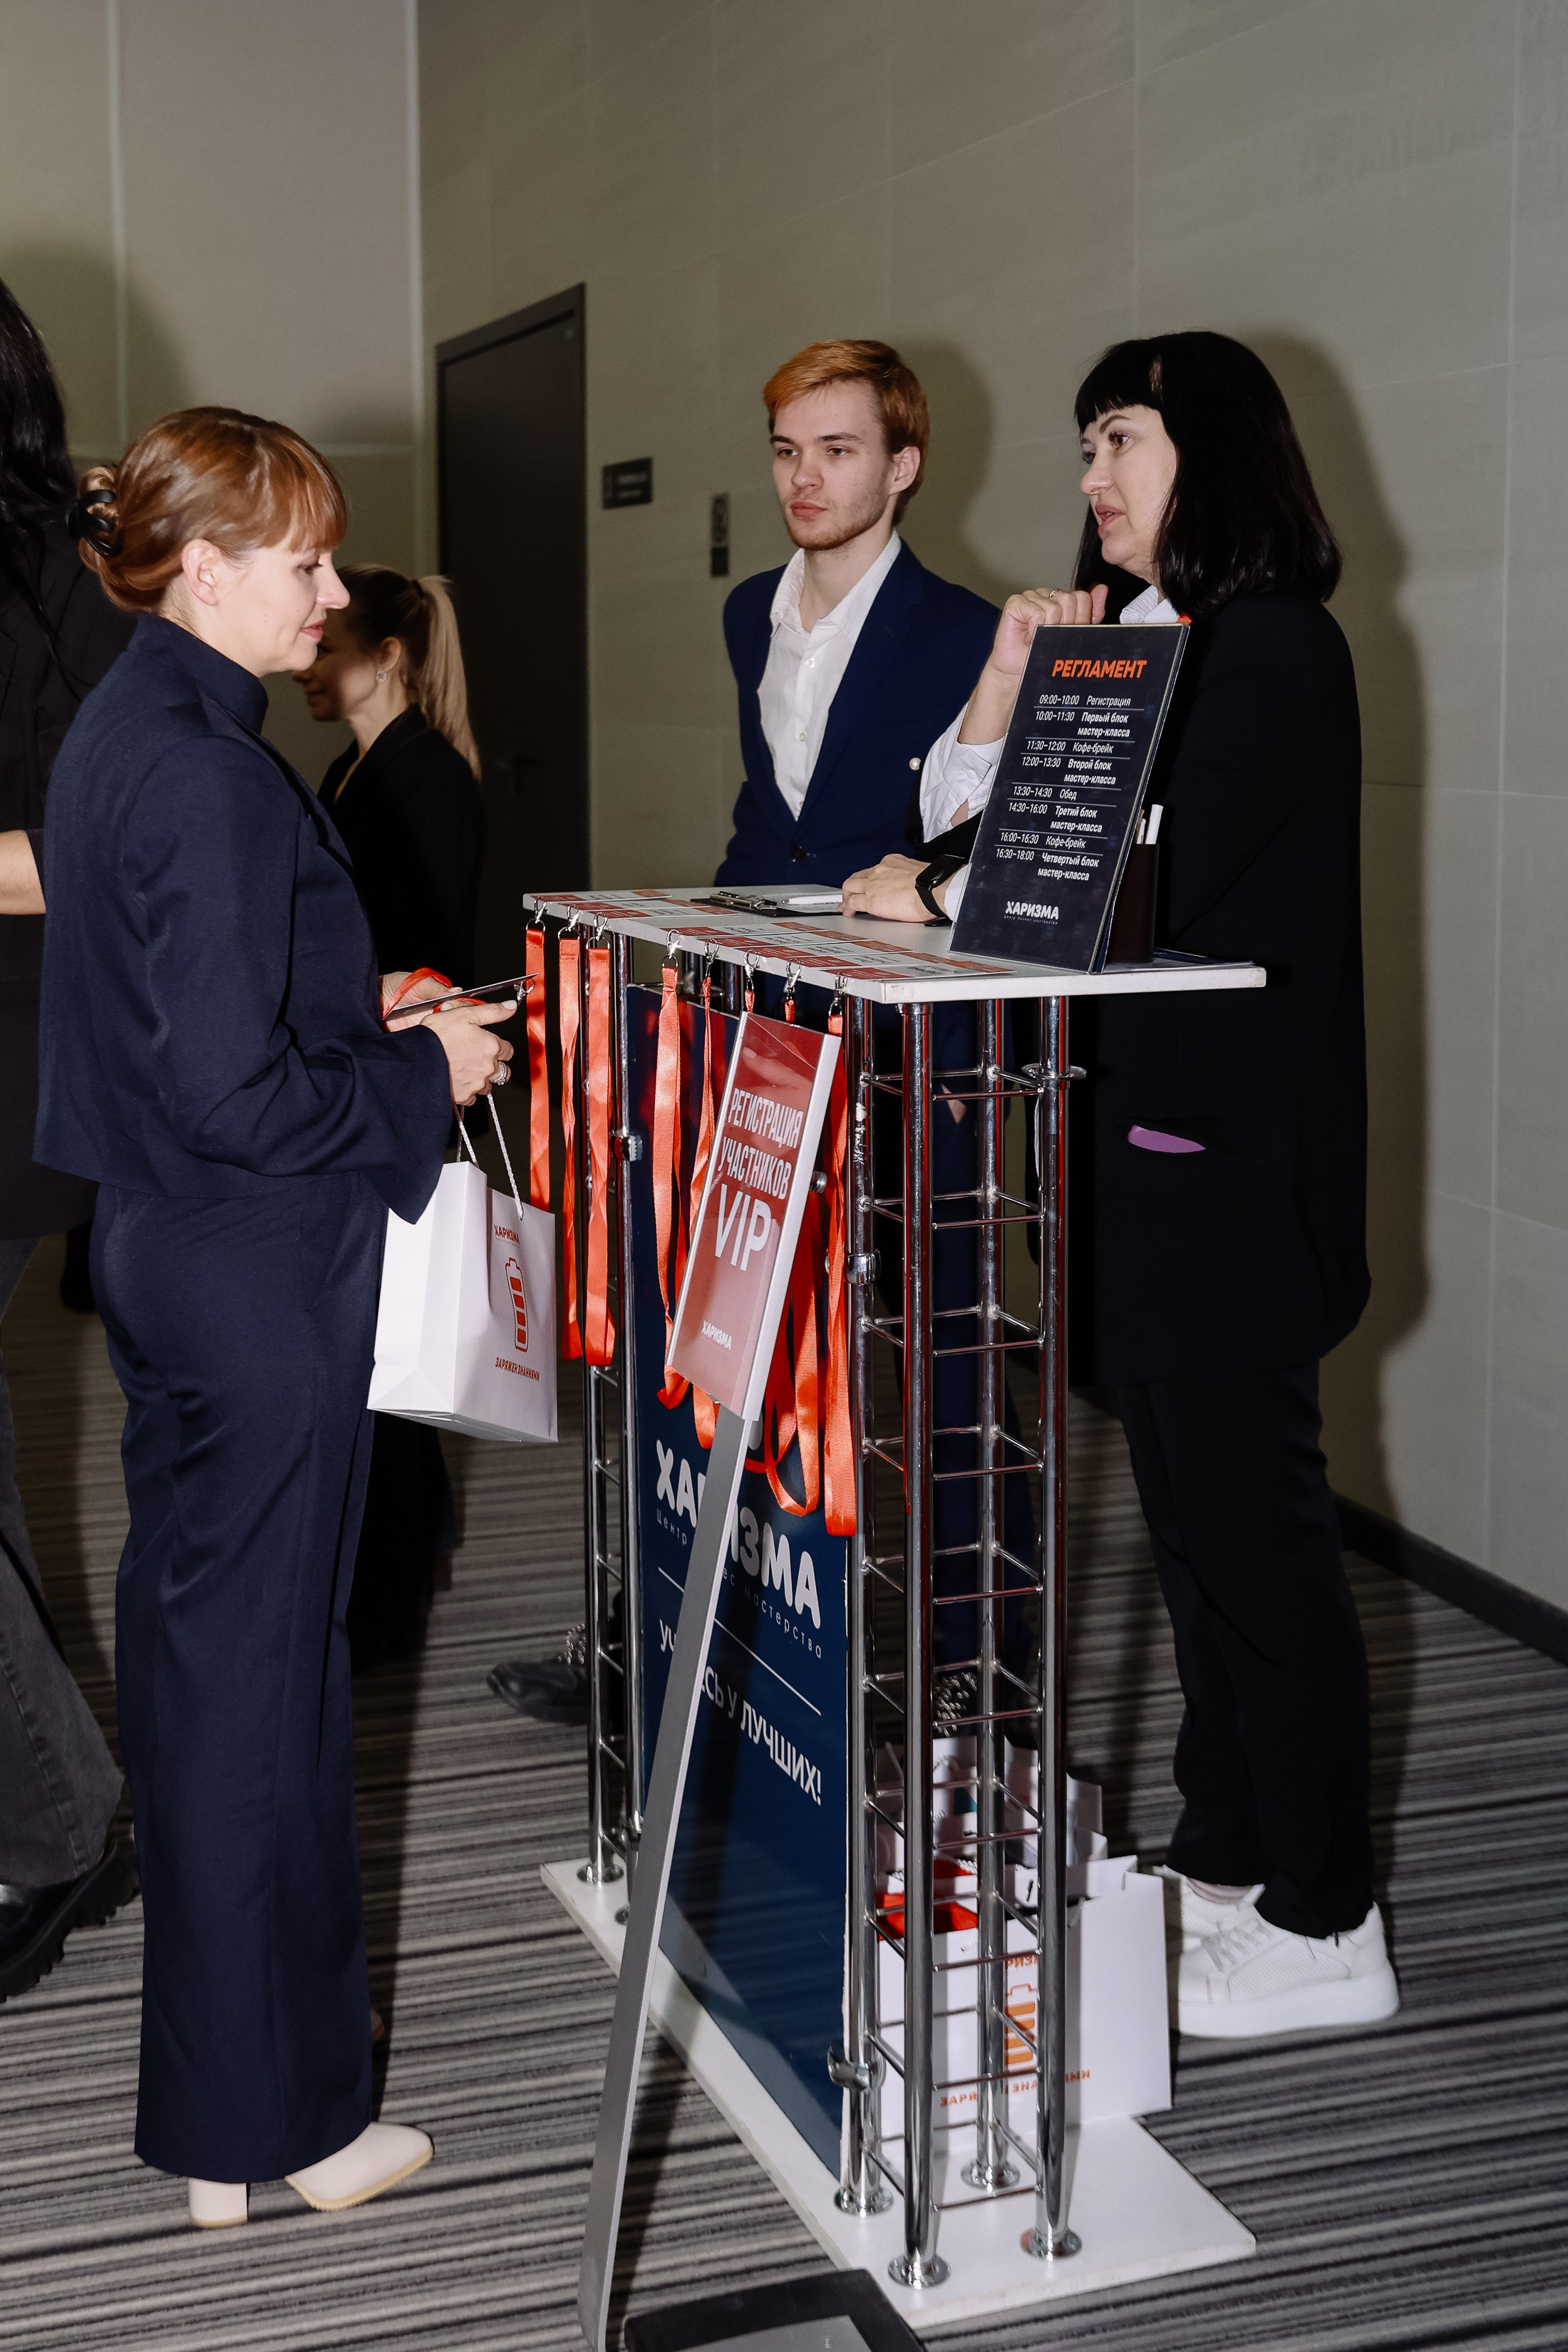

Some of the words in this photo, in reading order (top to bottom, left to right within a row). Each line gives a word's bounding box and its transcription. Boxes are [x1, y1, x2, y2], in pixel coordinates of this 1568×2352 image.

[1051, 659, 1147, 678] РЕГЛАМЕНТ
[1086, 695, 1131, 708] Регистрация
[1081, 711, 1110, 724] Первый
[1110, 712, 1130, 723] блок
[1077, 727, 1130, 738] мастер-класса
[1073, 742, 1114, 754] Кофе-брейк
[1068, 758, 1093, 771] Второй
[1094, 759, 1113, 770] блок
[1064, 774, 1116, 785] мастер-класса
[1059, 788, 1078, 801] Обед
[1055, 805, 1080, 817] Третий
[1080, 806, 1098, 818] блок
[1051, 820, 1103, 832] мастер-класса
[1046, 835, 1086, 849] Кофе-брейк
[1041, 852, 1080, 866] Четвертый
[1080, 856, 1100, 867] блок
[1038, 867, 1090, 881] мастер-класса
[1005, 901, 1059, 920] ХАРИЗМА
[728, 1088, 804, 1149] РЕГИСТРАЦИЯ
[718, 1136, 792, 1200] УЧАСТНИКОВ
[494, 1224, 520, 1244] ХАРИЗМА
[715, 1183, 772, 1272] VIP
[701, 1320, 733, 1351] ХАРИЗМА
[495, 1357, 518, 1374] ЗАРЯЖЕН
[728, 1685, 737, 1718] У
[741, 1700, 821, 1806] ЛУЧШИХ!
